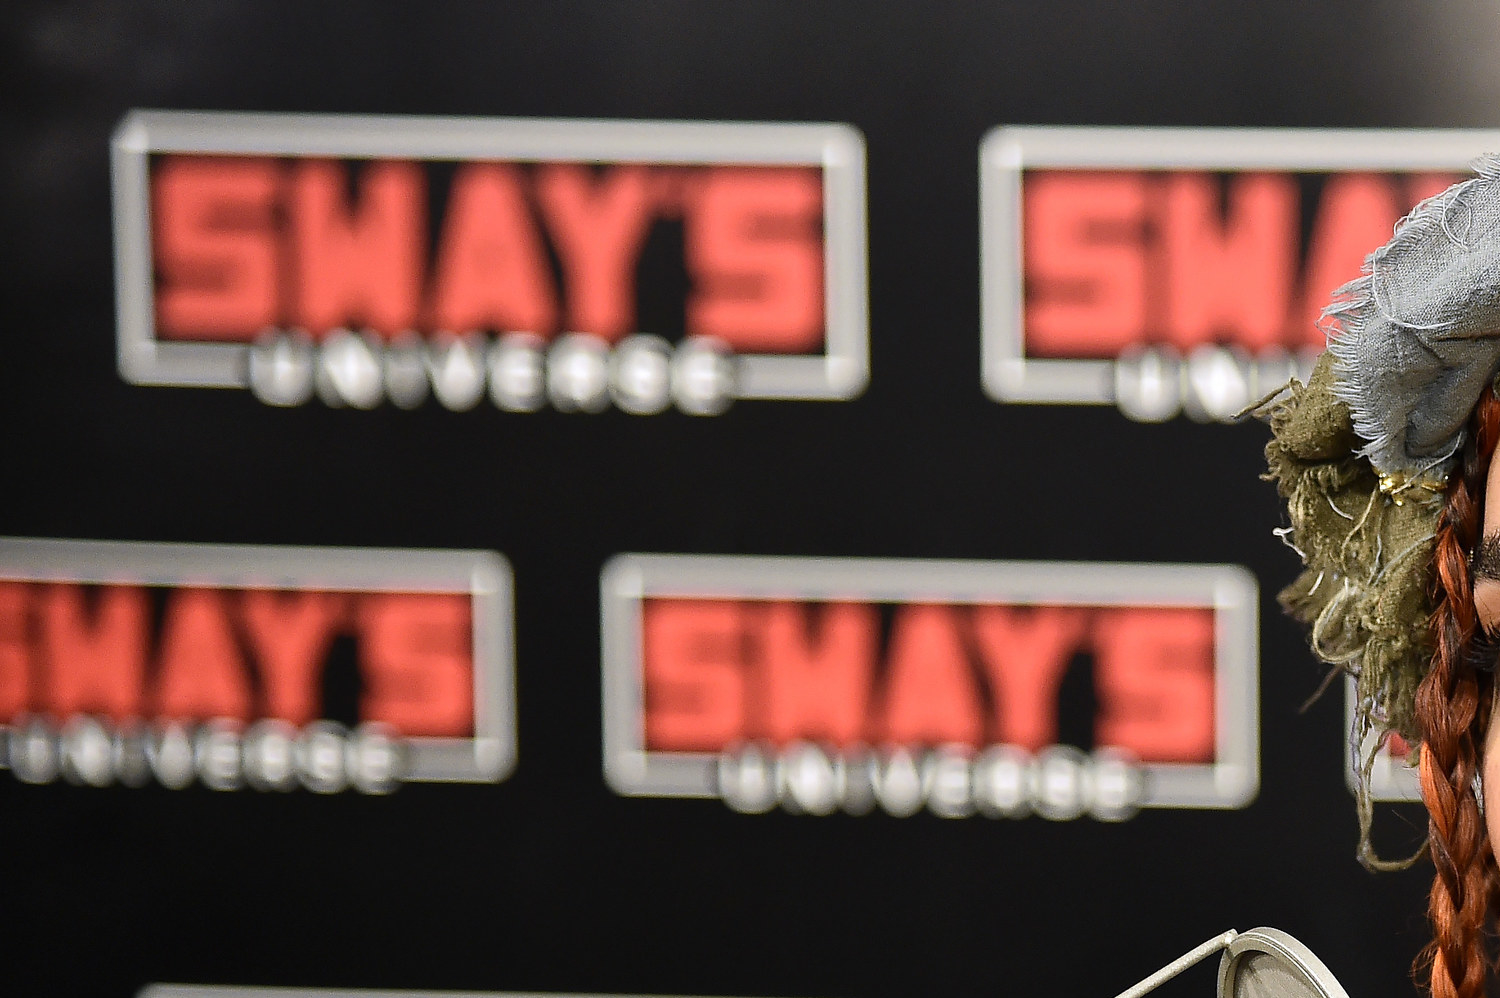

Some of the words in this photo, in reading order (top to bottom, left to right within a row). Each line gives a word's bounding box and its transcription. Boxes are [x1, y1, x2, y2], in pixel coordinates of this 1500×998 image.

[250, 327, 735, 416] UNIVERSE
[643, 596, 1216, 763] SWAY'S
[9, 712, 404, 796] UNIVERSE
[718, 739, 1144, 823] UNIVERSE
